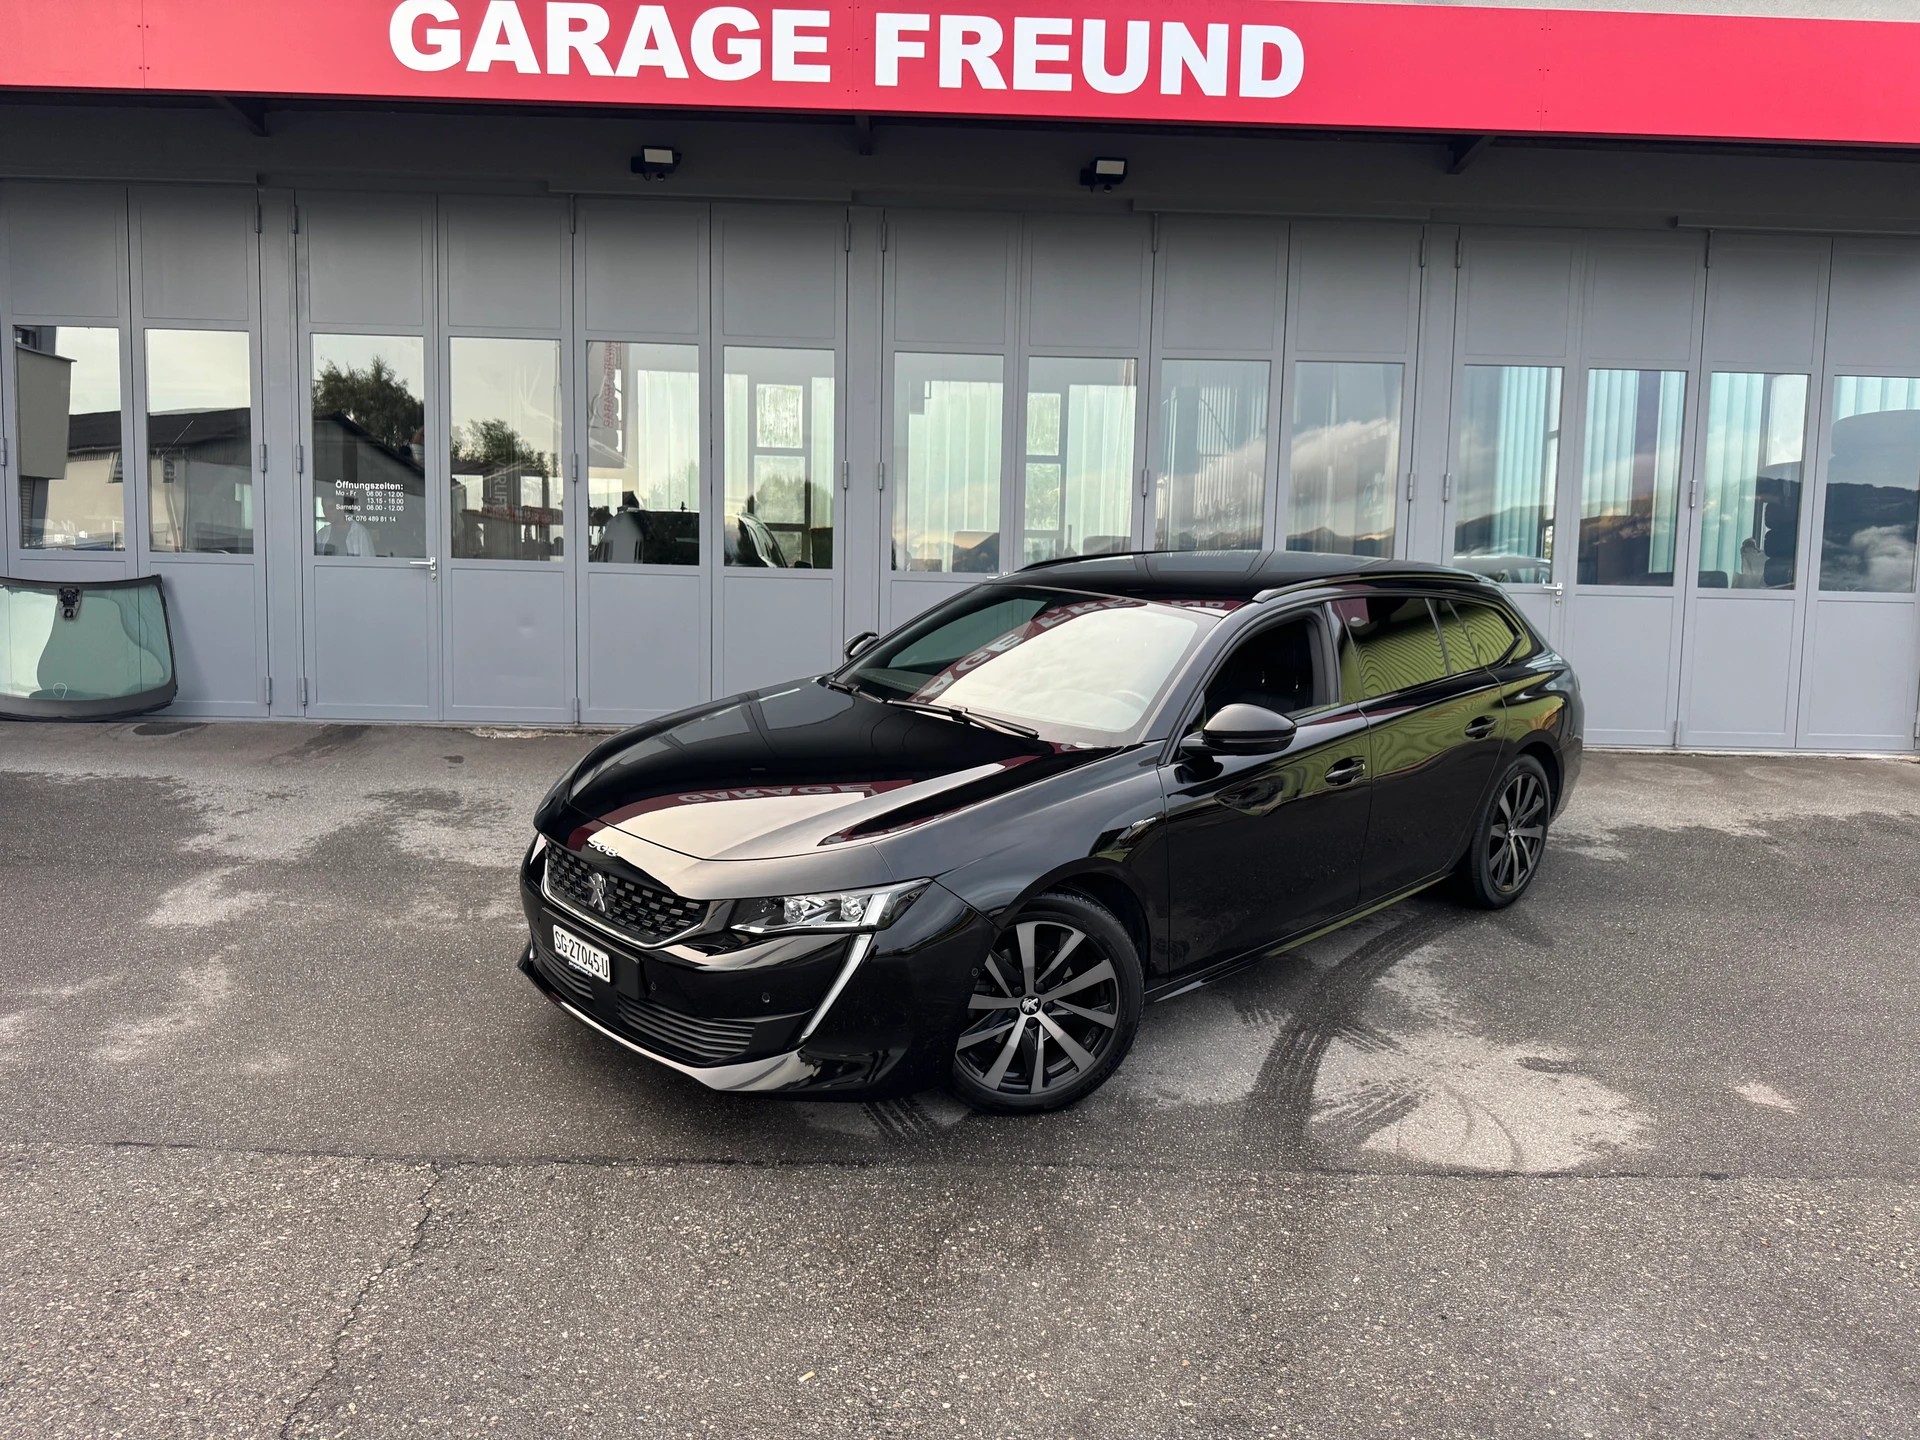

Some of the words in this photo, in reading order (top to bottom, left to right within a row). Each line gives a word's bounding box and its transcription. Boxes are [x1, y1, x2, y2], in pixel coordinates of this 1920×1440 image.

[388, 0, 833, 84] GARAGE
[874, 13, 1305, 98] FREUND
[335, 480, 404, 490] Öffnungszeiten:
